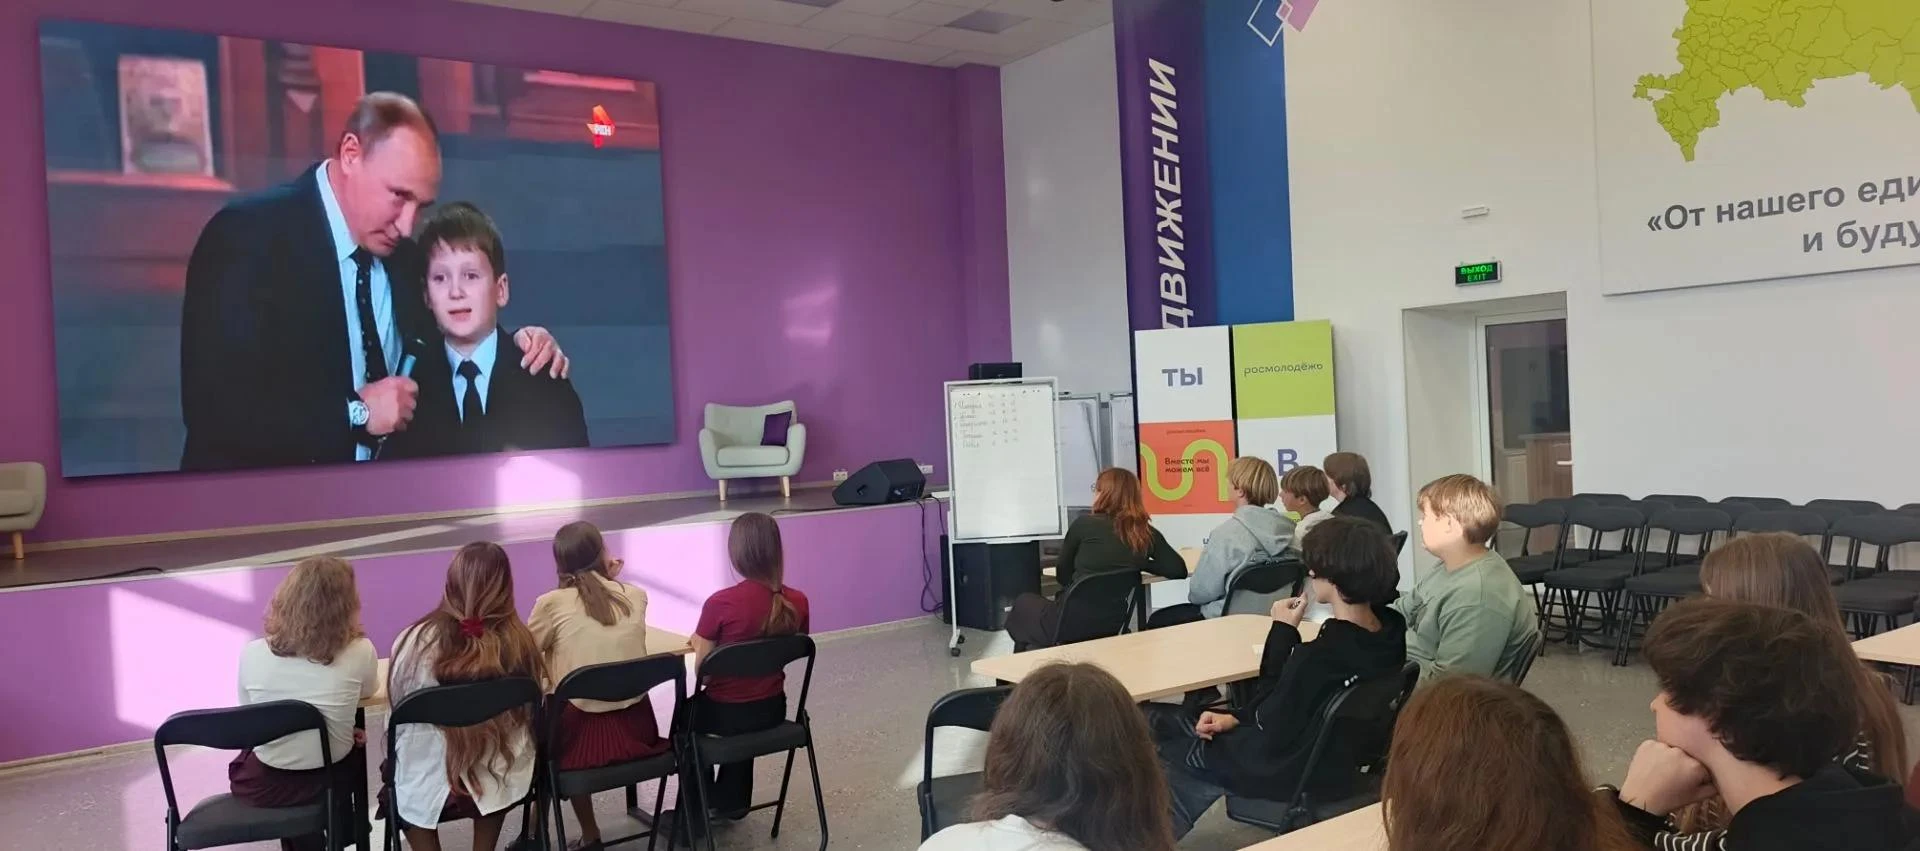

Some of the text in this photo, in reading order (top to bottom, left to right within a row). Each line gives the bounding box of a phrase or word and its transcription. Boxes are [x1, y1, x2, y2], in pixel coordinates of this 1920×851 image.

[1648, 204, 1705, 231] «От
[1716, 186, 1845, 223] нашего
[1803, 231, 1823, 253] и
[1461, 264, 1493, 274] ВЫХОД
[1467, 273, 1486, 281] EXIT
[1164, 457, 1194, 465] Вместе
